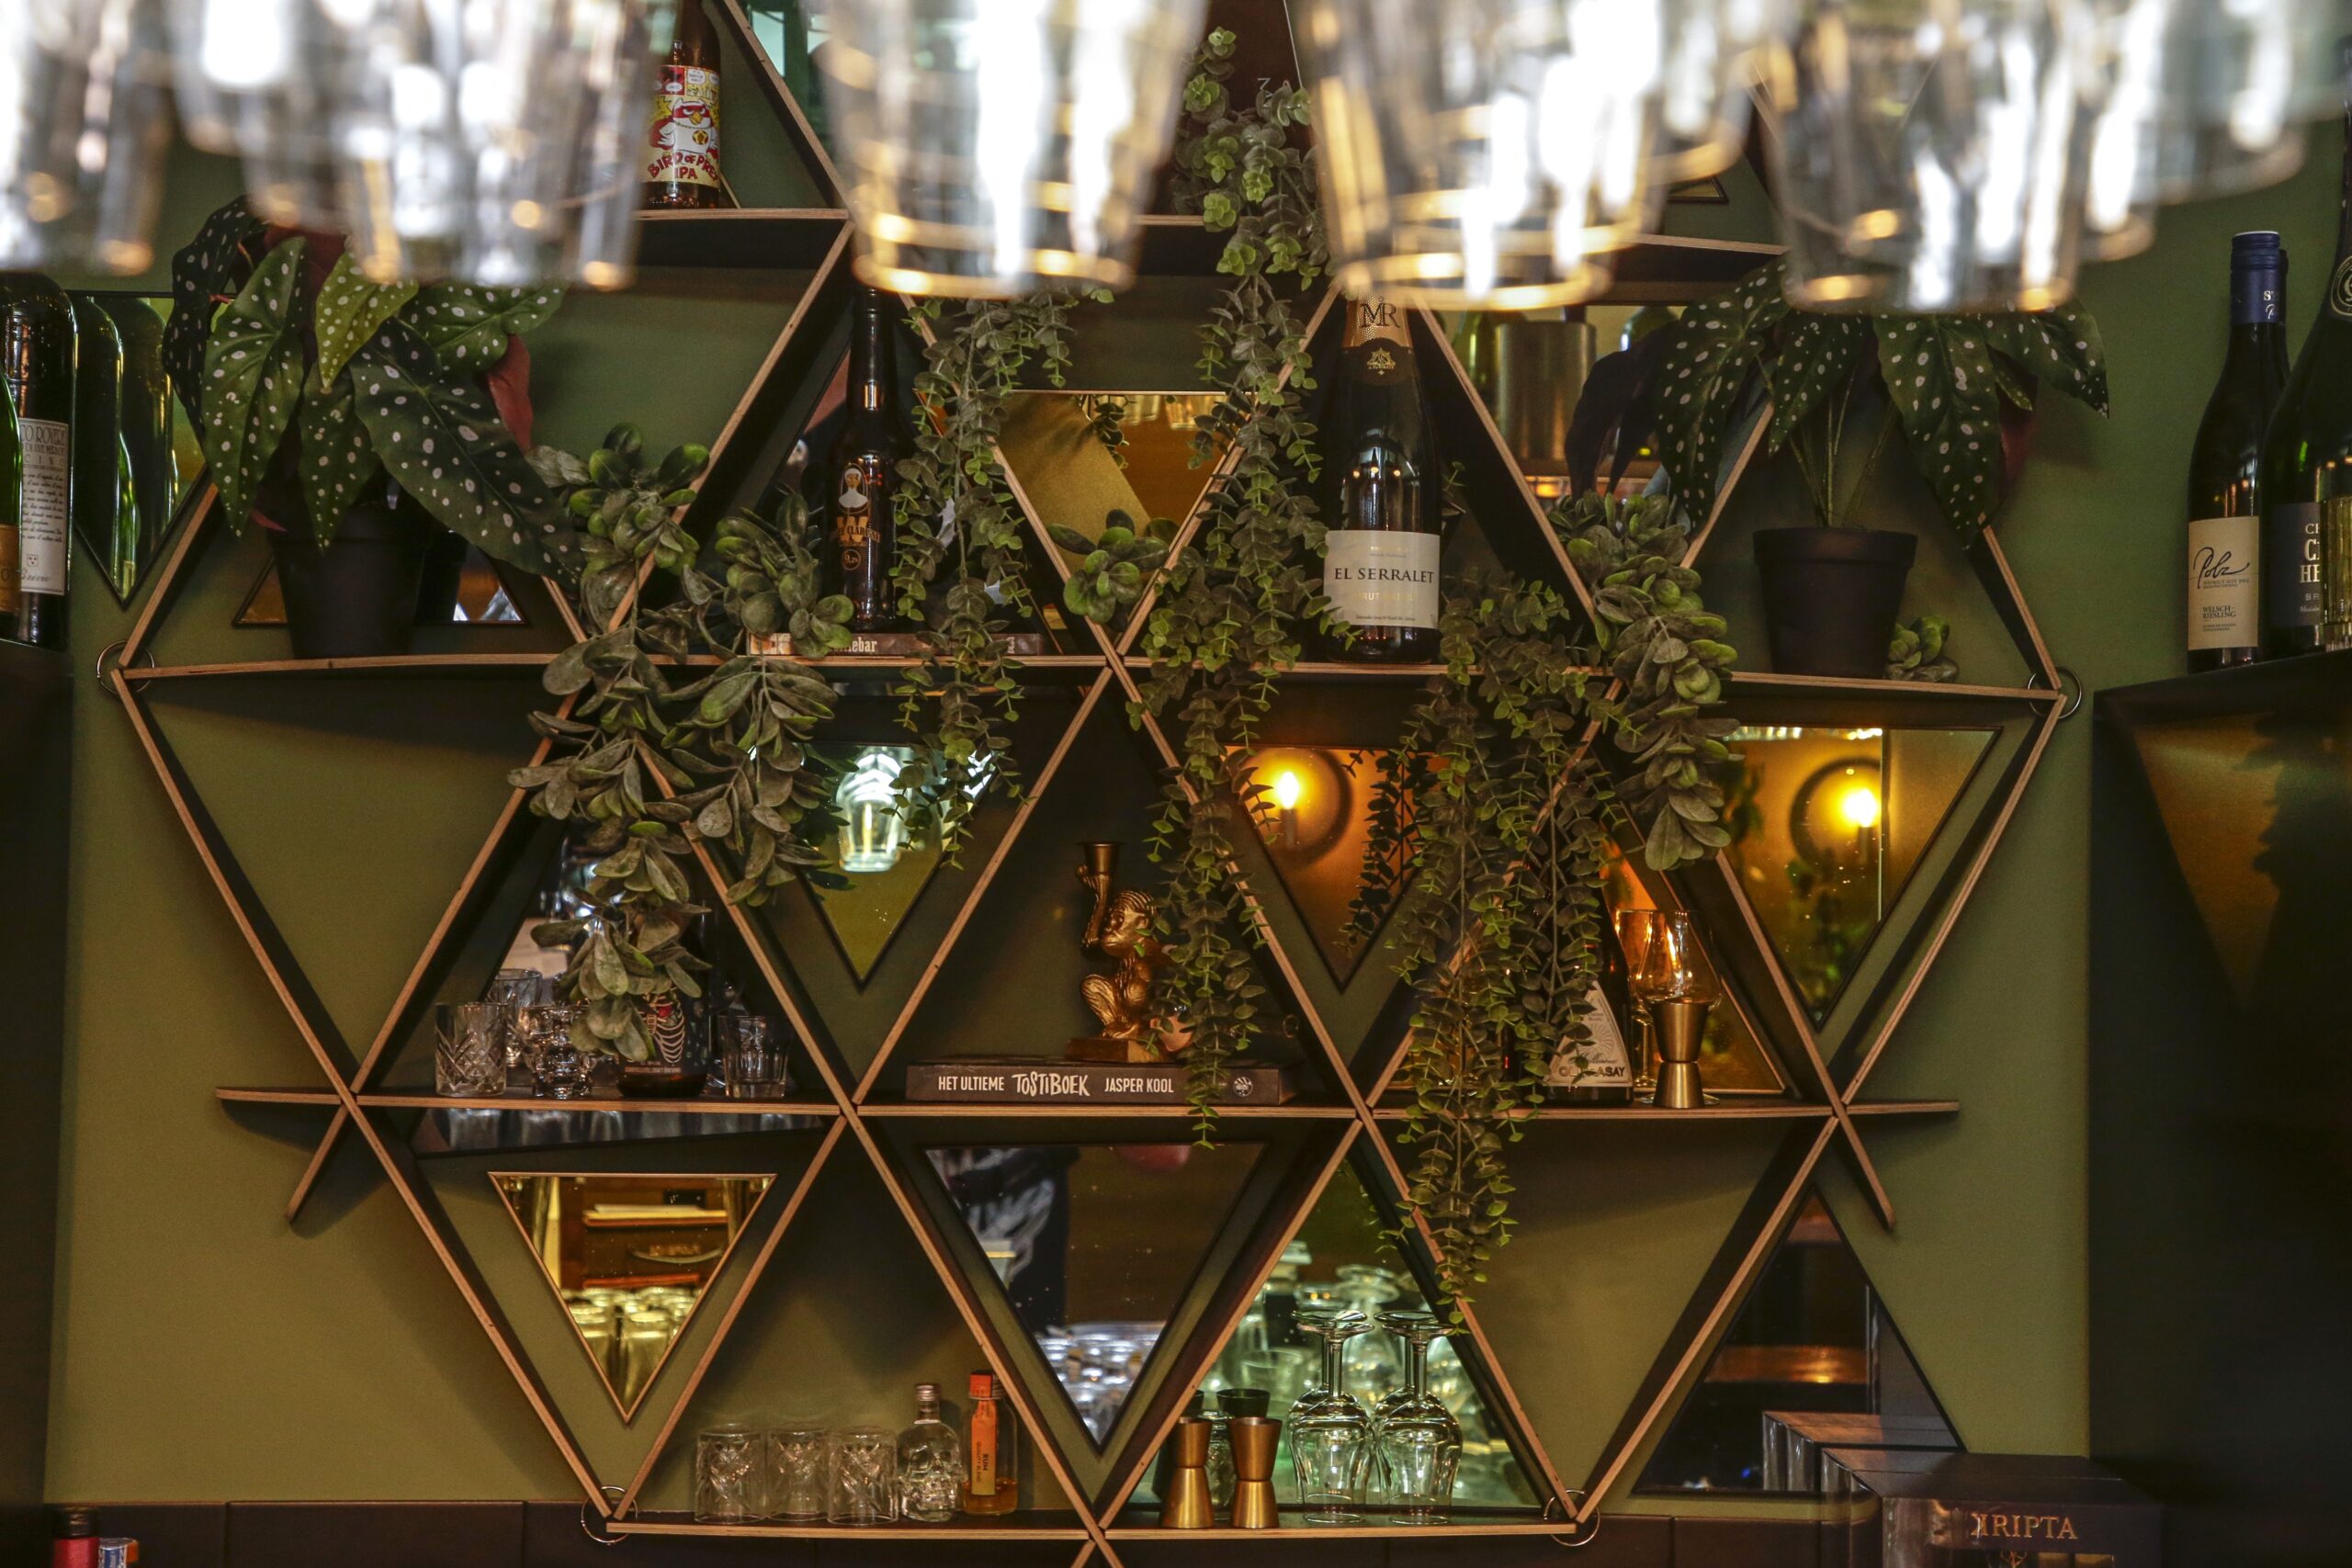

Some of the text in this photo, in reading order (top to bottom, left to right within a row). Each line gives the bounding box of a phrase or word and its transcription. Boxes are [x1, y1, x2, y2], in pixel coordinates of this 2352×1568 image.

[648, 152, 684, 178] BIRD
[684, 154, 695, 164] OF
[674, 167, 698, 179] IPA
[1335, 568, 1434, 583] EL SERRALET
[2193, 547, 2250, 589] Polz
[2202, 611, 2236, 619] RIESLING
[938, 1076, 958, 1091] HET
[960, 1076, 1005, 1091] ULTIEME
[1104, 1077, 1145, 1093] JASPER
[1146, 1077, 1174, 1094] KOOL
